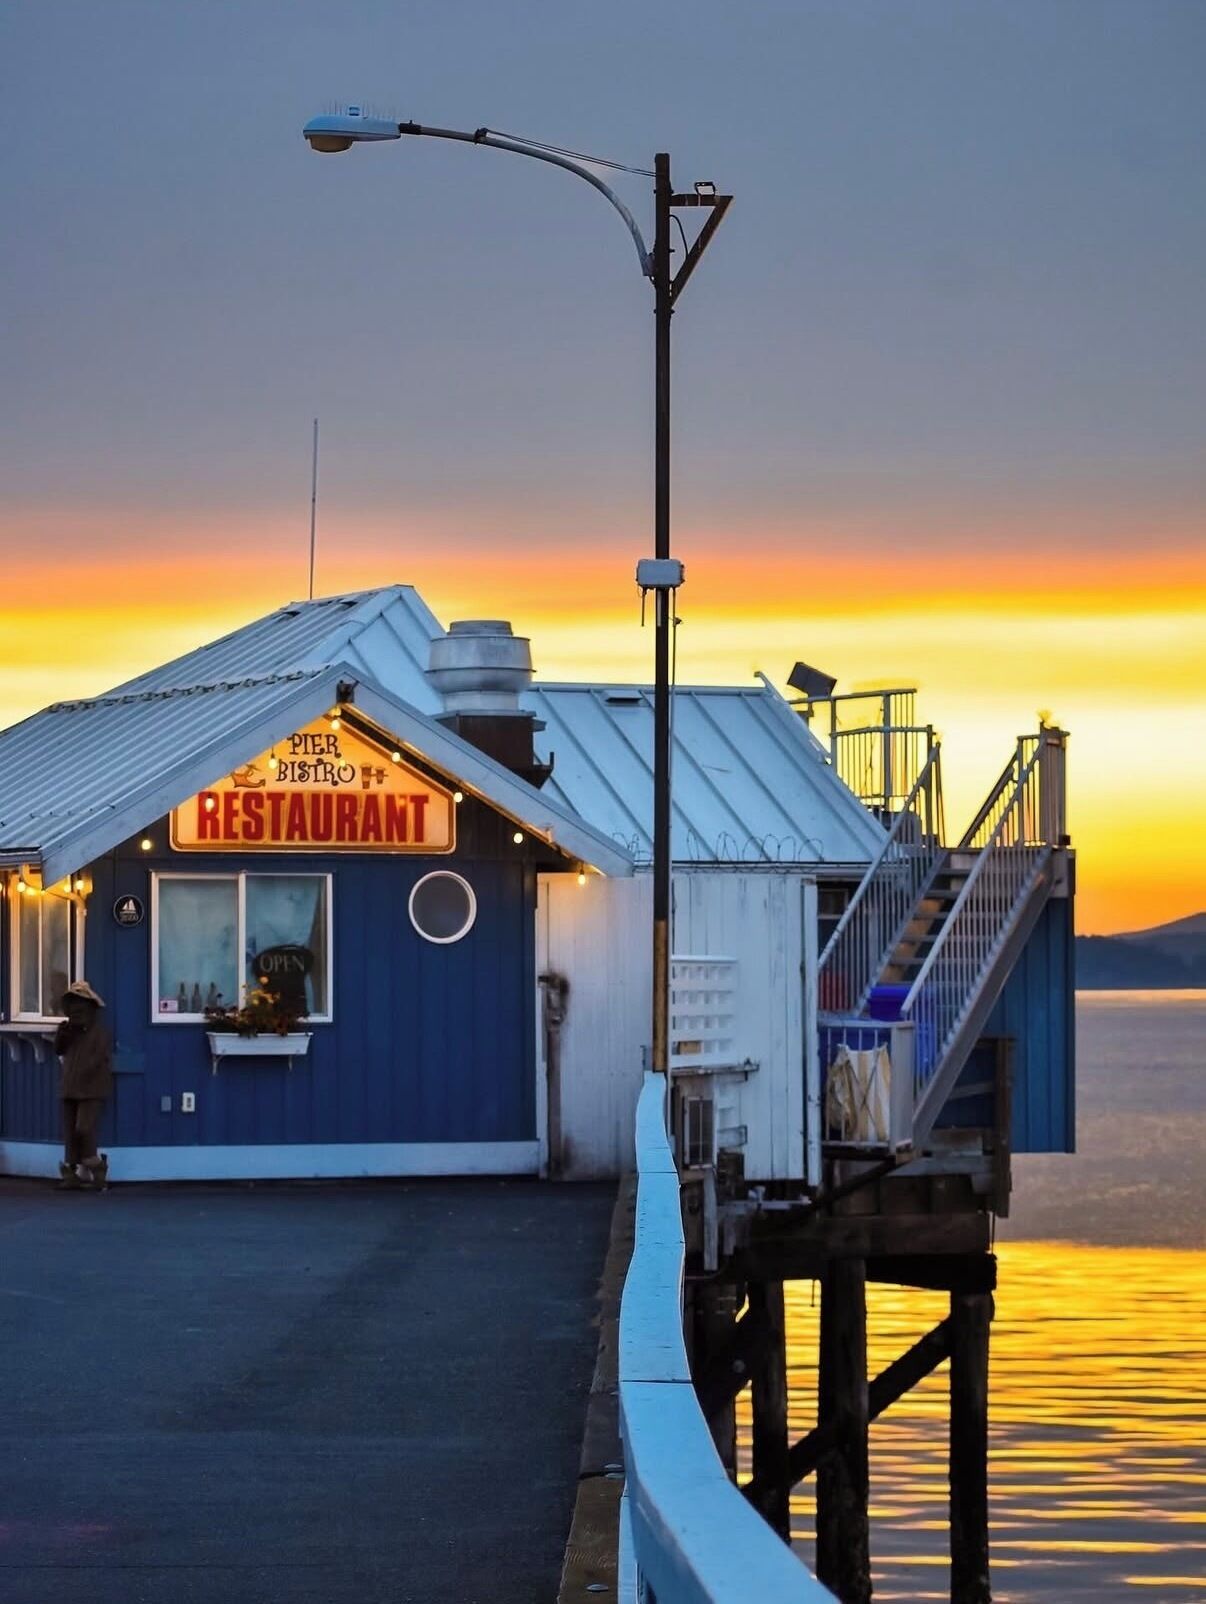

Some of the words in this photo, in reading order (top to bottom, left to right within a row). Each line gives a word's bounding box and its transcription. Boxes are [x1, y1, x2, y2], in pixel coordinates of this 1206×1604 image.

[286, 732, 342, 758] PIER
[275, 758, 355, 786] BISTRO
[196, 790, 429, 843] RESTAURANT
[259, 954, 305, 973] OPEN
